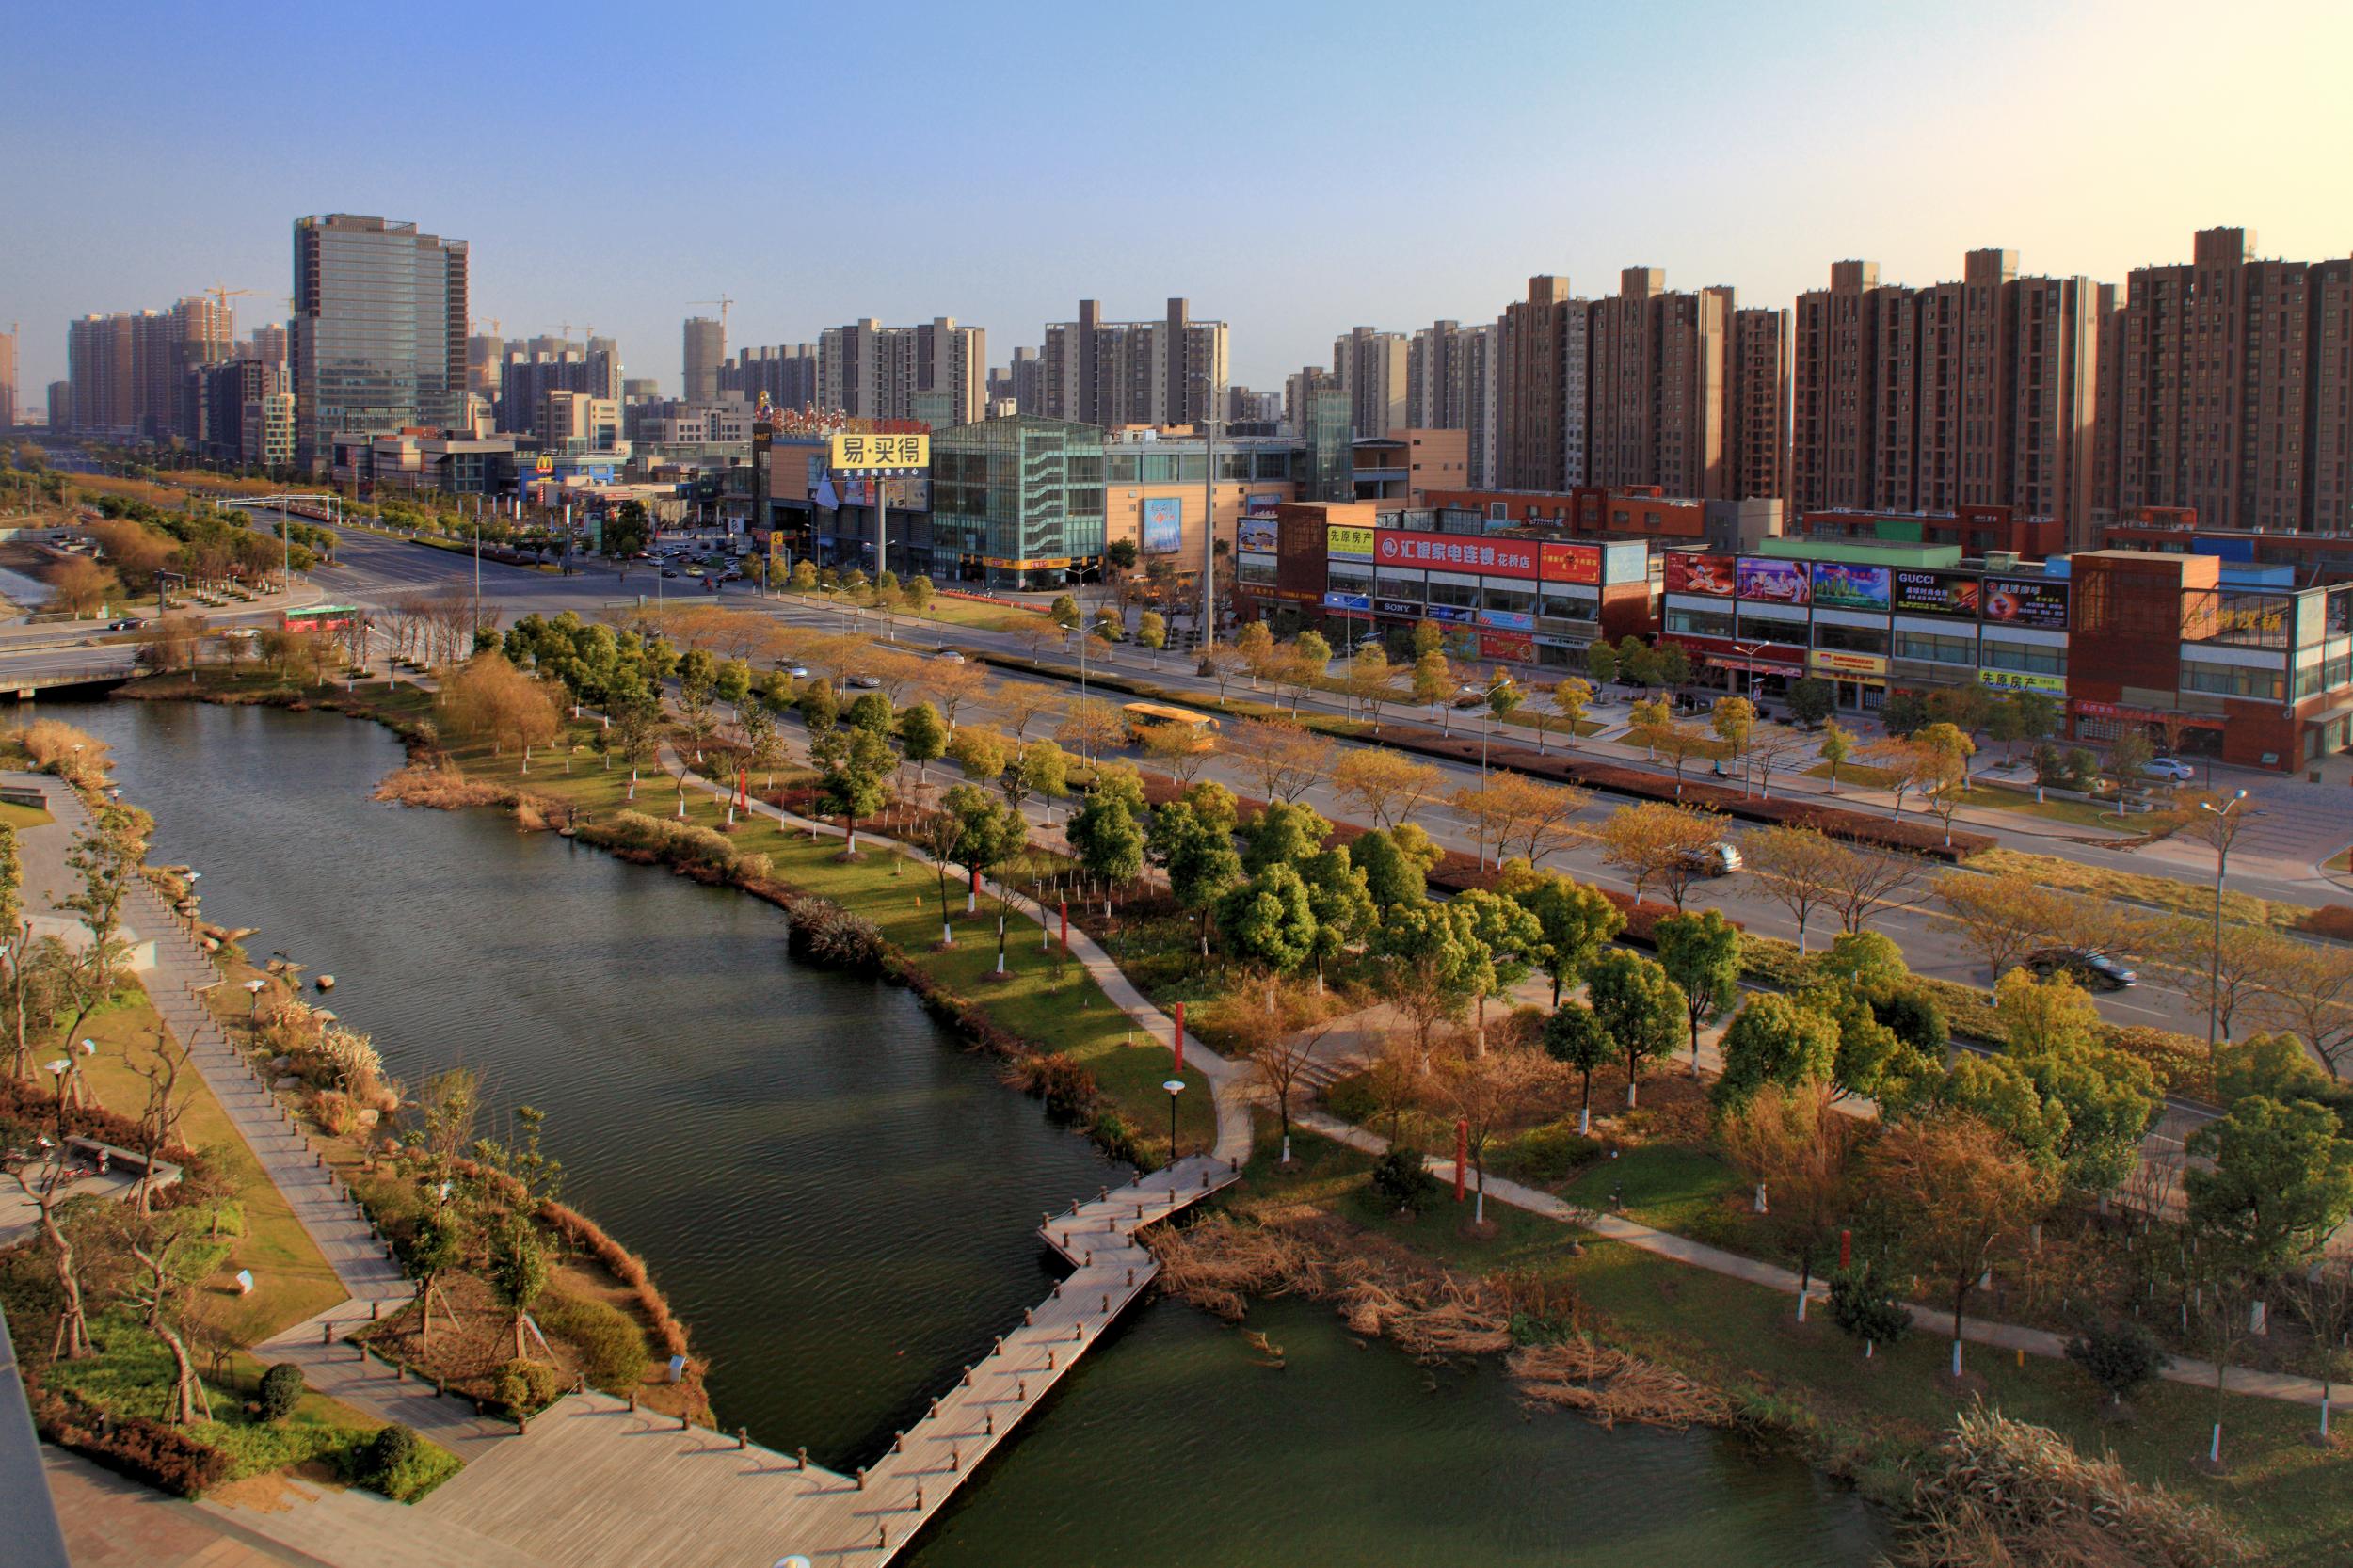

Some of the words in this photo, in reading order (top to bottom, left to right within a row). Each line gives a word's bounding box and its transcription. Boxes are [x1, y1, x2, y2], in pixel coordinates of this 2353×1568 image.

[1330, 529, 1372, 544] 先原房产
[1401, 540, 1495, 566] 汇银家电连锁
[1898, 573, 1935, 584] GUCCI
[1384, 602, 1411, 613] SONY
[1982, 671, 2037, 690] 先原房产
